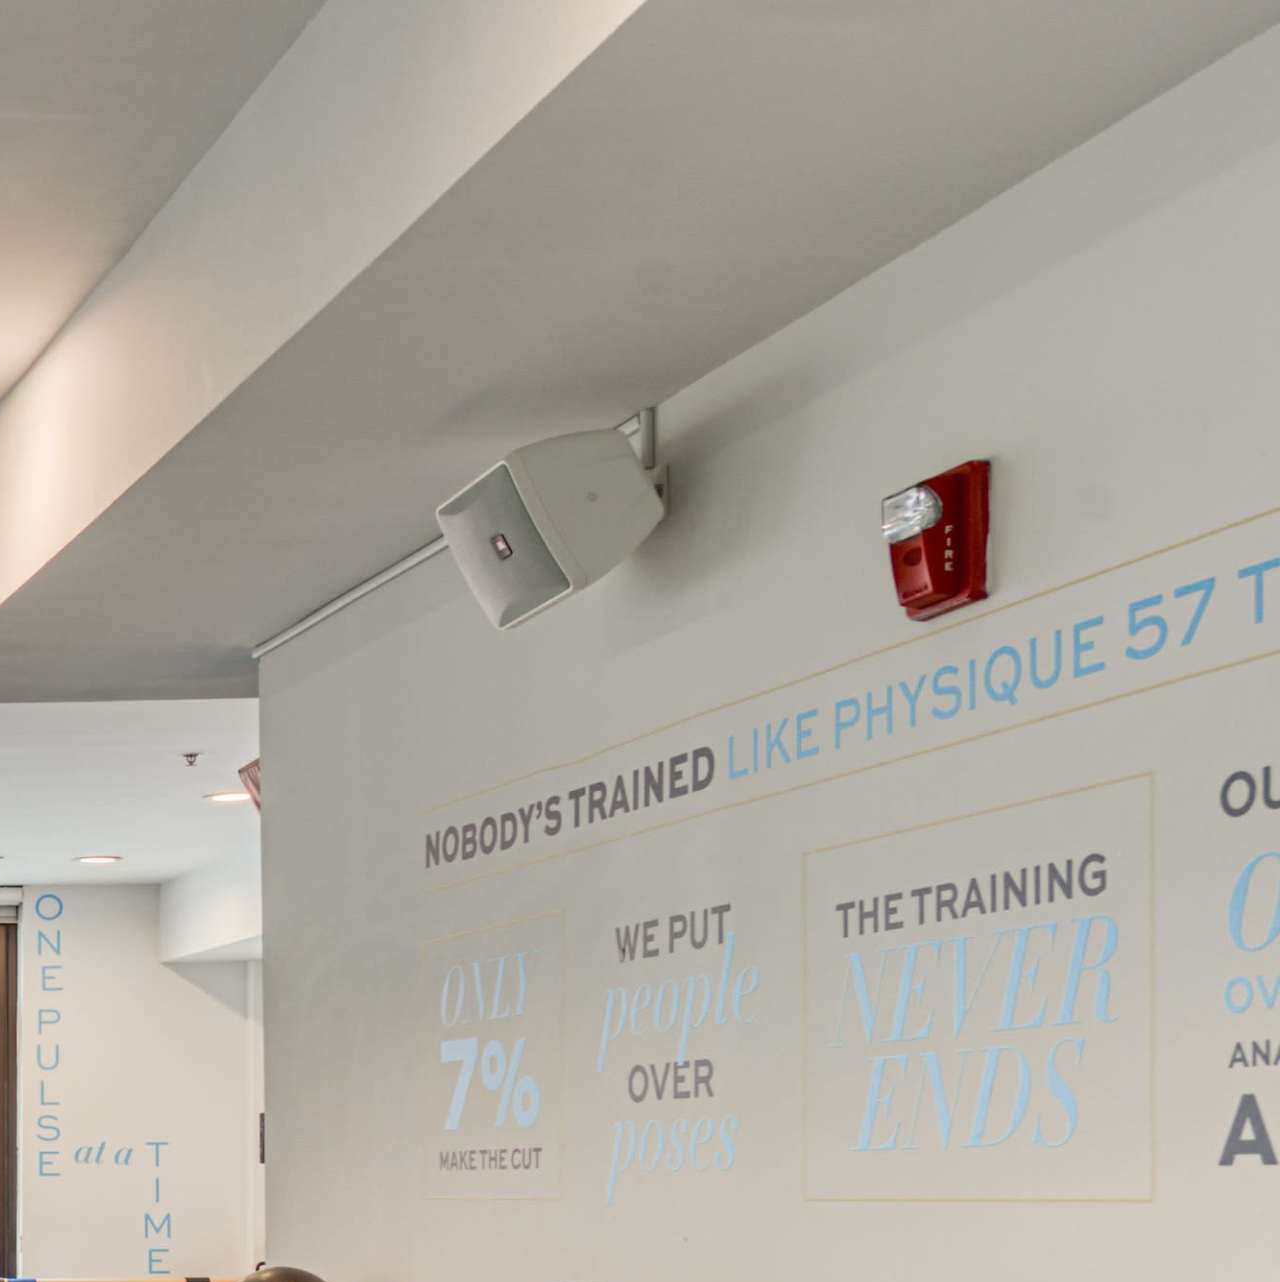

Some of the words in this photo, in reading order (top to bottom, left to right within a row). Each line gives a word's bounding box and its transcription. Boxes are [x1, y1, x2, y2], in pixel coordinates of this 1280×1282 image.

[944, 524, 955, 572] FIRE
[424, 795, 562, 868] NOBODY'S
[568, 746, 715, 829] TRAINED
[727, 708, 820, 780] LIKE
[834, 615, 1105, 750] PHYSIQUE
[1125, 576, 1216, 660] 57
[34, 893, 65, 992] ONE
[615, 918, 660, 963] WE
[668, 903, 732, 953] PUT
[835, 891, 905, 938] THE
[911, 853, 1108, 926] TRAINING
[596, 930, 764, 1072] people
[825, 913, 1120, 1049] NEVER
[36, 1008, 62, 1177] PULSE
[440, 1037, 541, 1131] 7%
[628, 1058, 715, 1104] OVER
[847, 1036, 1087, 1153] ENDS
[74, 1141, 107, 1165] at
[114, 1147, 135, 1166] a
[439, 1150, 477, 1171] MAKE
[479, 1149, 508, 1170] THE
[510, 1147, 543, 1170] CUT
[606, 1113, 741, 1209] poses
[144, 1141, 172, 1275] TIME
